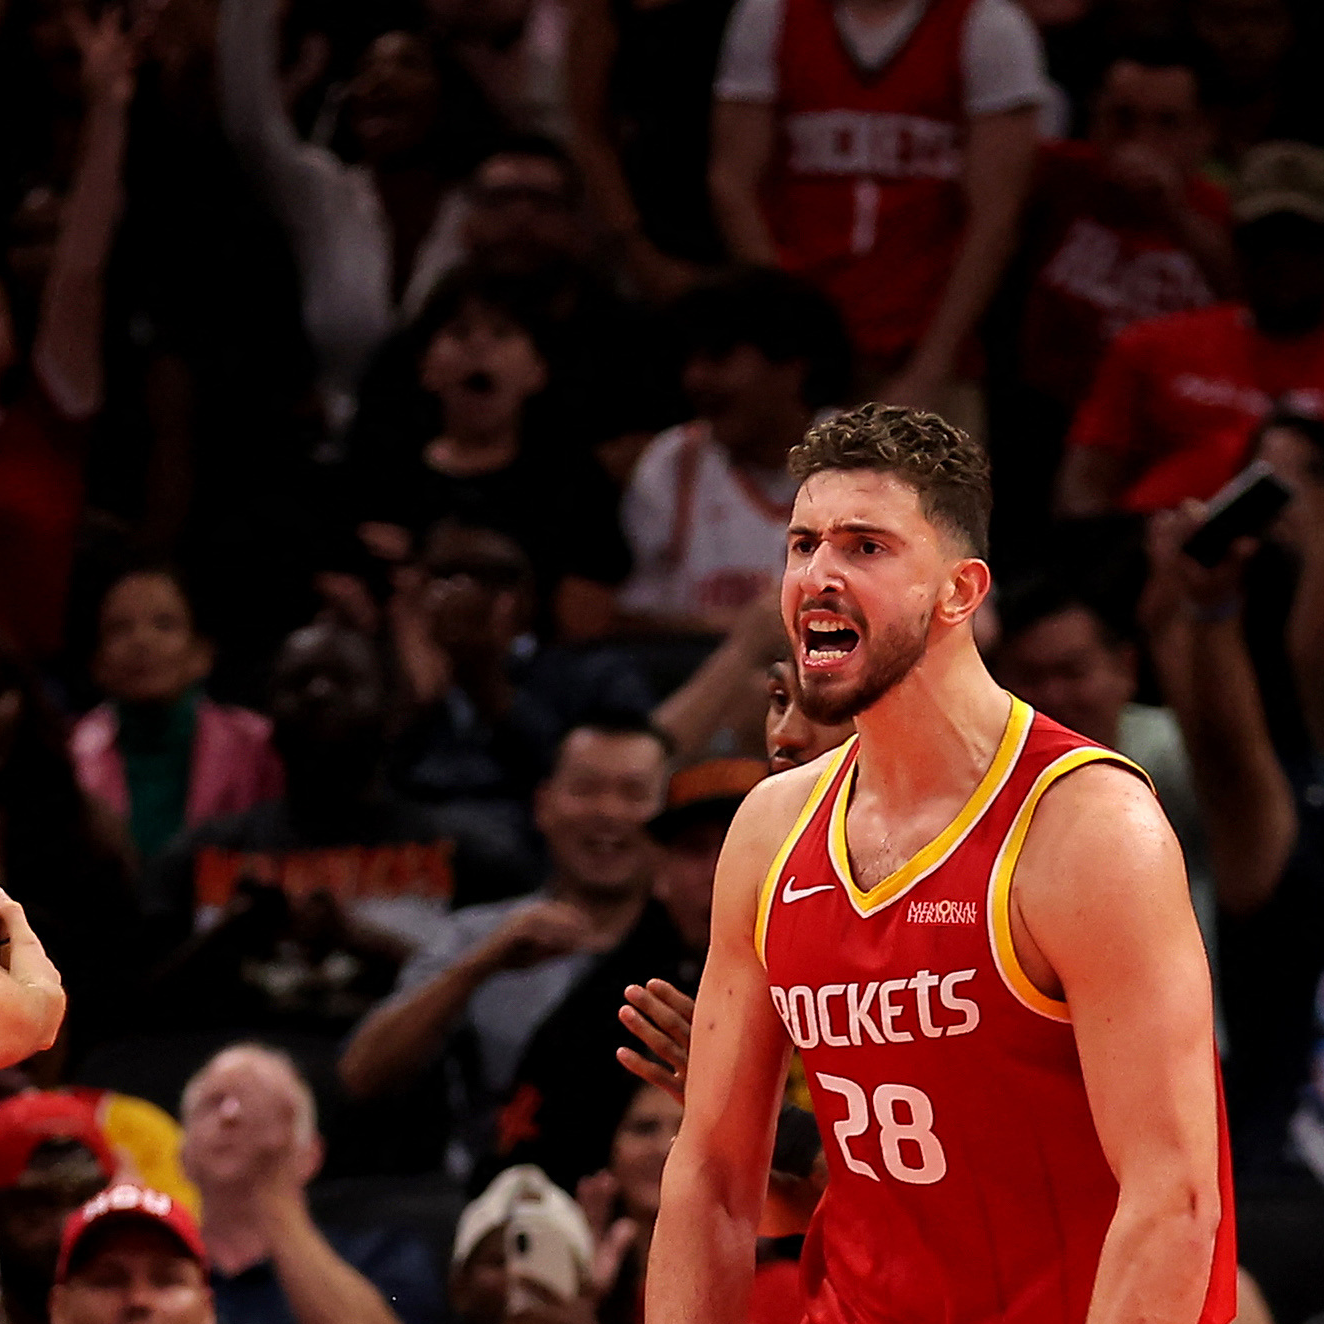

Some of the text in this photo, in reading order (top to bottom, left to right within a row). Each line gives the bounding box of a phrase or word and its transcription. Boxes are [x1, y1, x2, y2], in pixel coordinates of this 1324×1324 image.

[909, 900, 977, 914] MEMORIAL
[906, 908, 977, 924] HERMANN
[815, 1071, 947, 1185] 28
